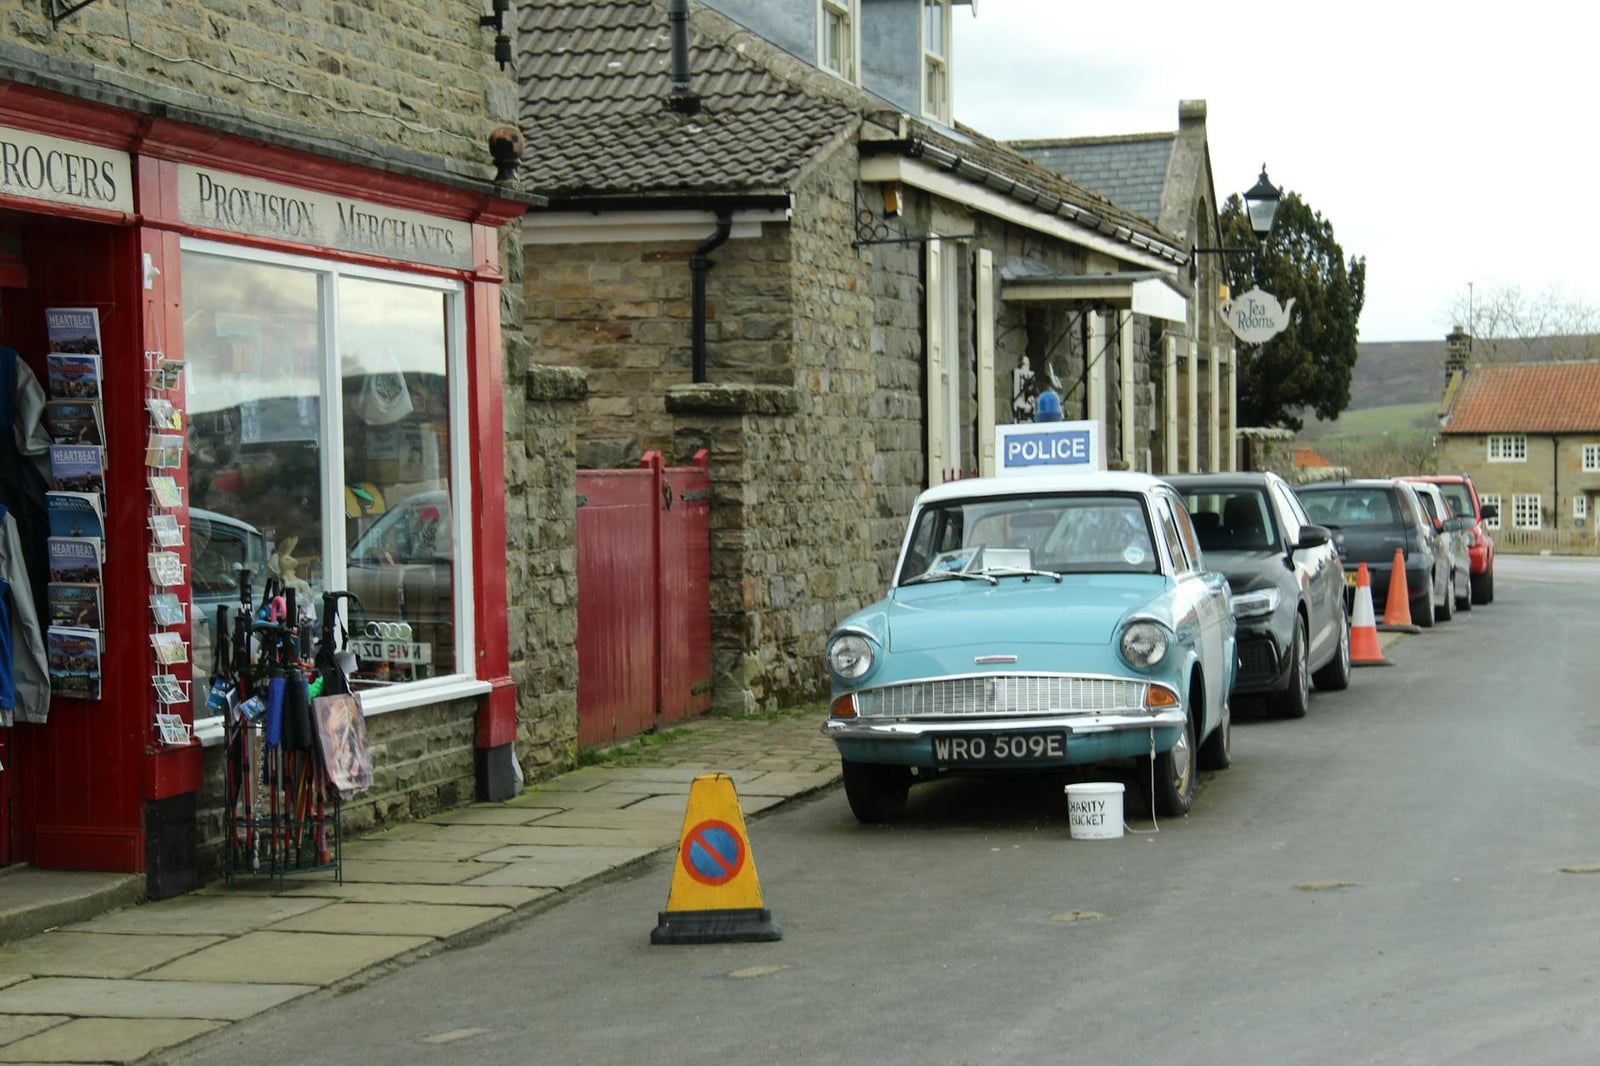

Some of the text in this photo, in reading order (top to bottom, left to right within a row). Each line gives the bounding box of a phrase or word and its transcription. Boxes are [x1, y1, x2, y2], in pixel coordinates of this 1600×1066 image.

[0, 141, 116, 202] ROCERS
[196, 172, 314, 237] PROVISION
[1245, 298, 1265, 317] Tea
[49, 314, 92, 326] HEARTBEAT
[1236, 310, 1275, 331] Rooms
[53, 449, 97, 462] HEARTBEAT
[1008, 438, 1086, 461] POLICE
[51, 543, 93, 555] HEARTBEAT
[935, 735, 1064, 760] WRO 509E
[1071, 813, 1106, 826] BUCKET
